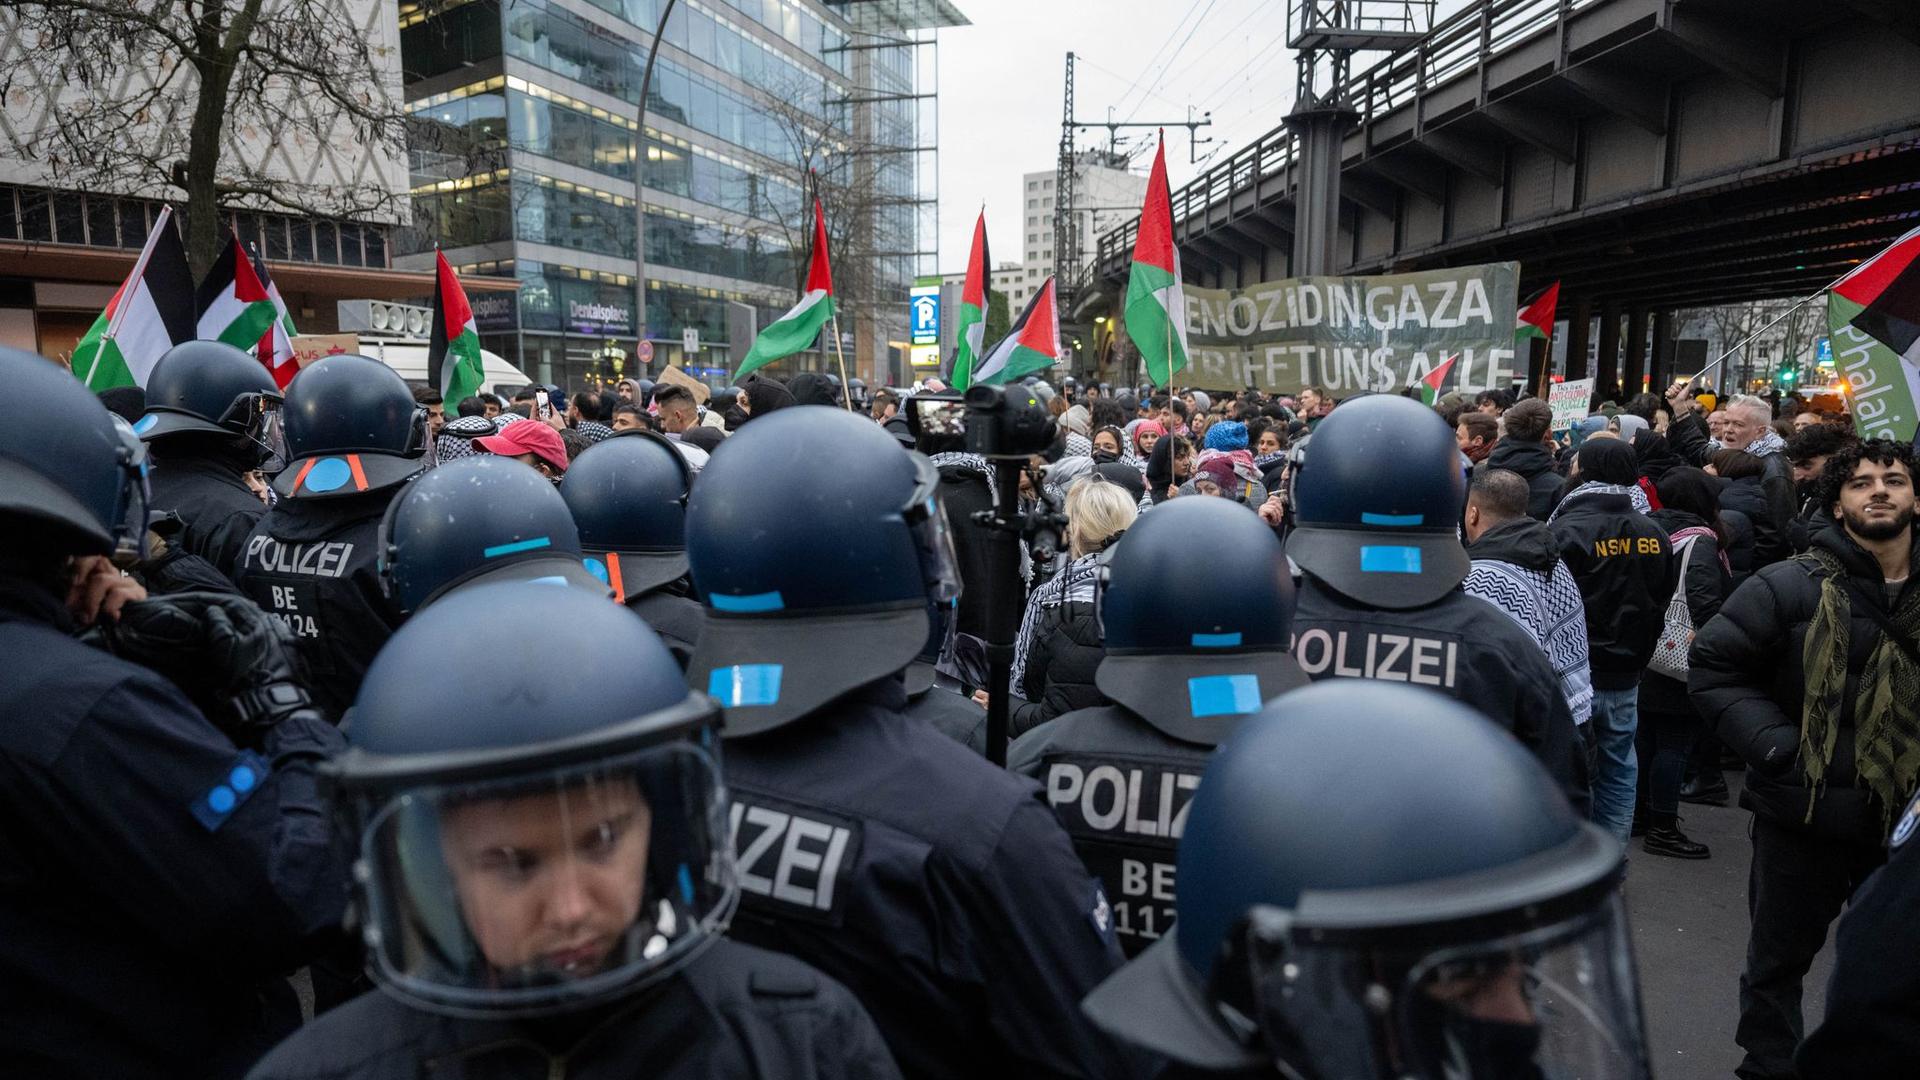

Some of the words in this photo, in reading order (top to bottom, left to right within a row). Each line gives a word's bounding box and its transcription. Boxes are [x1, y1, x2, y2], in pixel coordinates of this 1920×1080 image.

[570, 300, 629, 323] Dentalsplace
[1184, 284, 1323, 337] ENOZID
[1327, 284, 1361, 329] IN
[1366, 278, 1493, 330] GAZA
[1187, 345, 1315, 391] TRIFFT
[1320, 347, 1396, 393] UNS
[244, 535, 354, 578] POLIZEI
[1637, 537, 1660, 555] 68
[272, 585, 298, 610] BE
[1290, 628, 1458, 688] OLIZEI
[1047, 763, 1203, 839] POLIZ
[1122, 858, 1177, 901] BE
